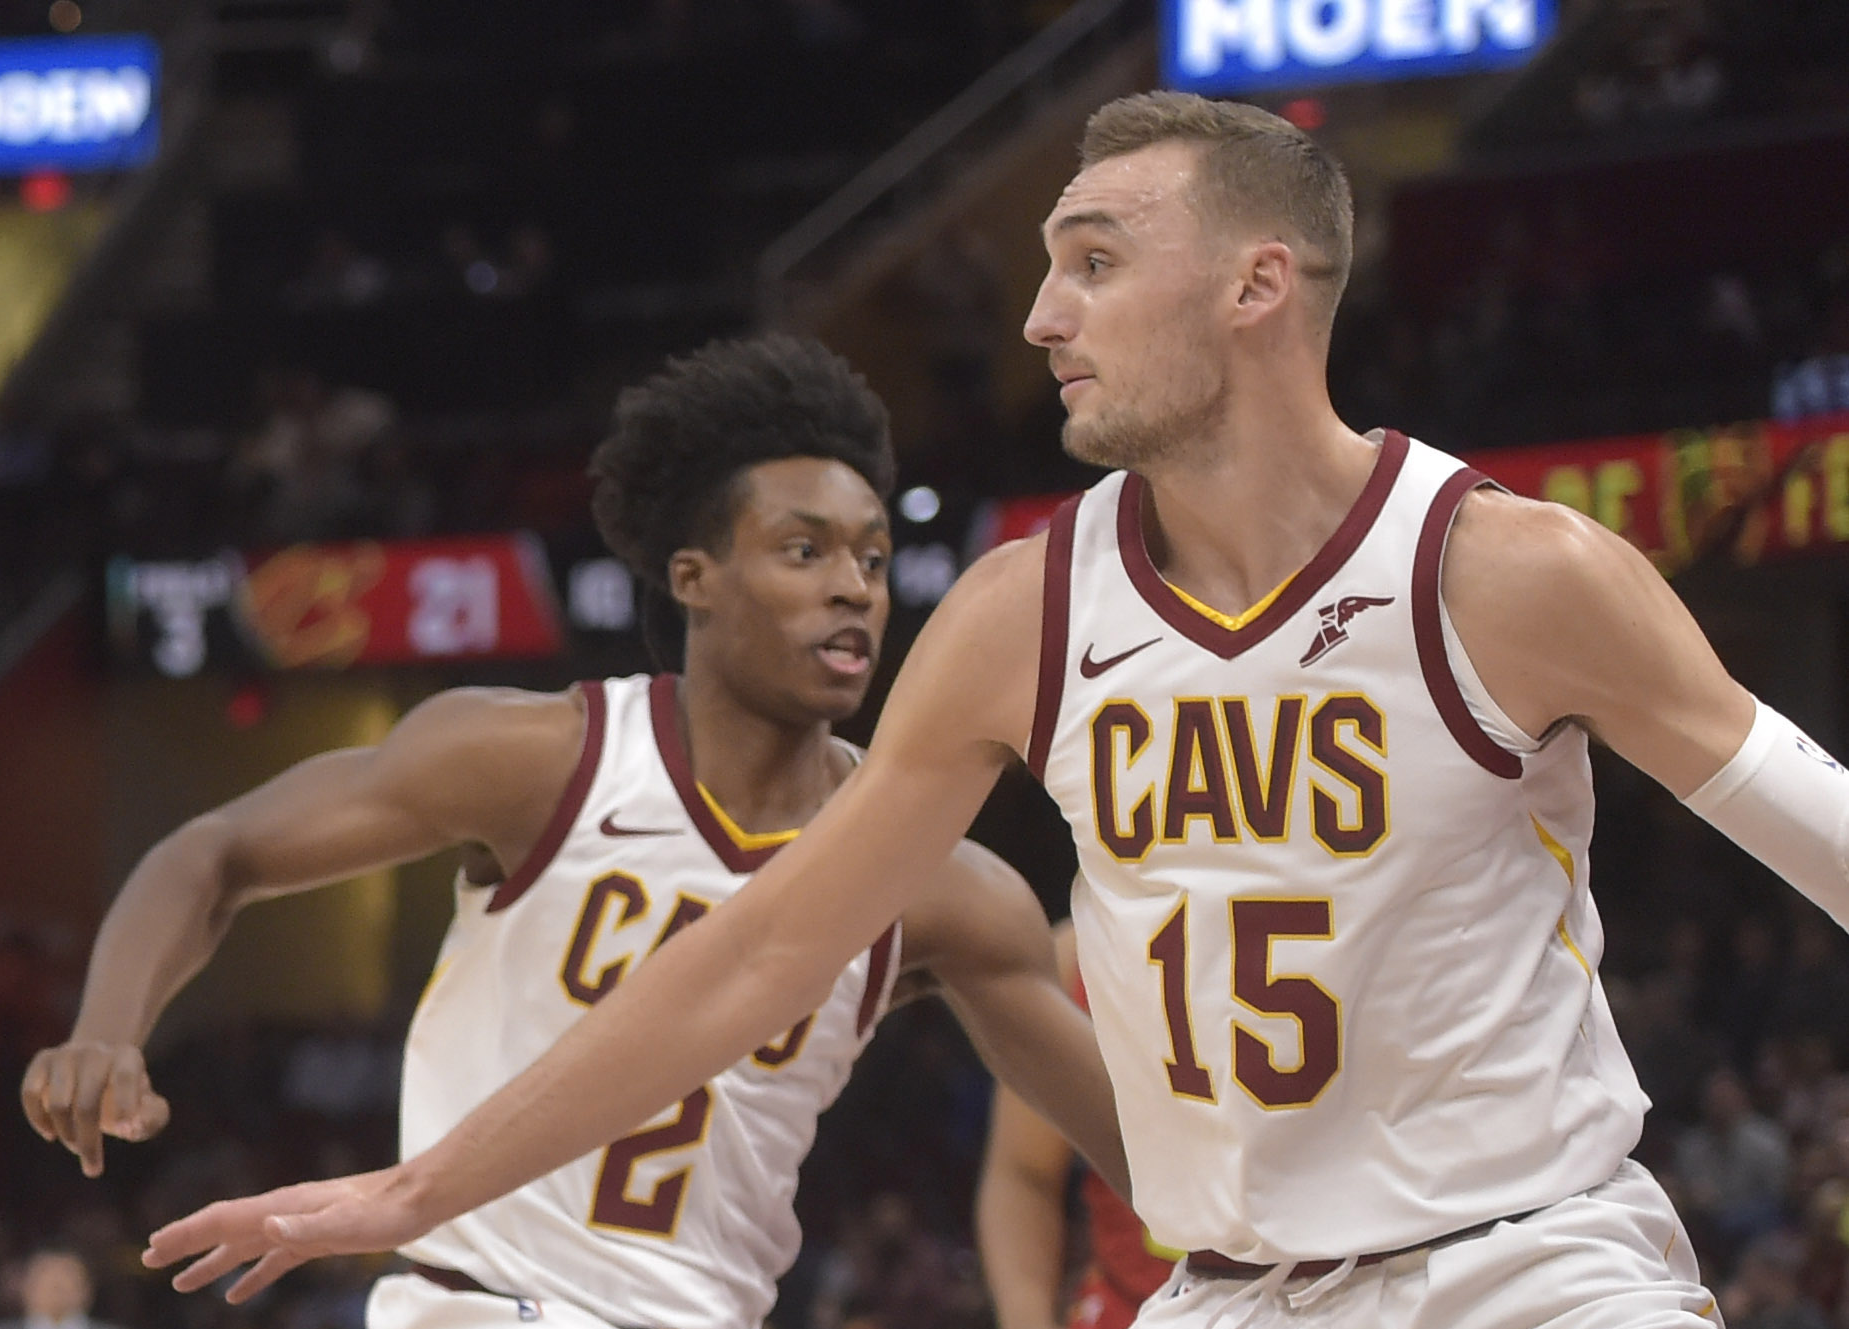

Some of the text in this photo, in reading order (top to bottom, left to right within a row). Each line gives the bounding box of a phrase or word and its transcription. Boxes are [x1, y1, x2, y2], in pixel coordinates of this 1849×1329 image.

[1088, 690, 1392, 865] CAVS
[1147, 892, 1344, 1112] 15
[587, 1083, 714, 1242] 2
